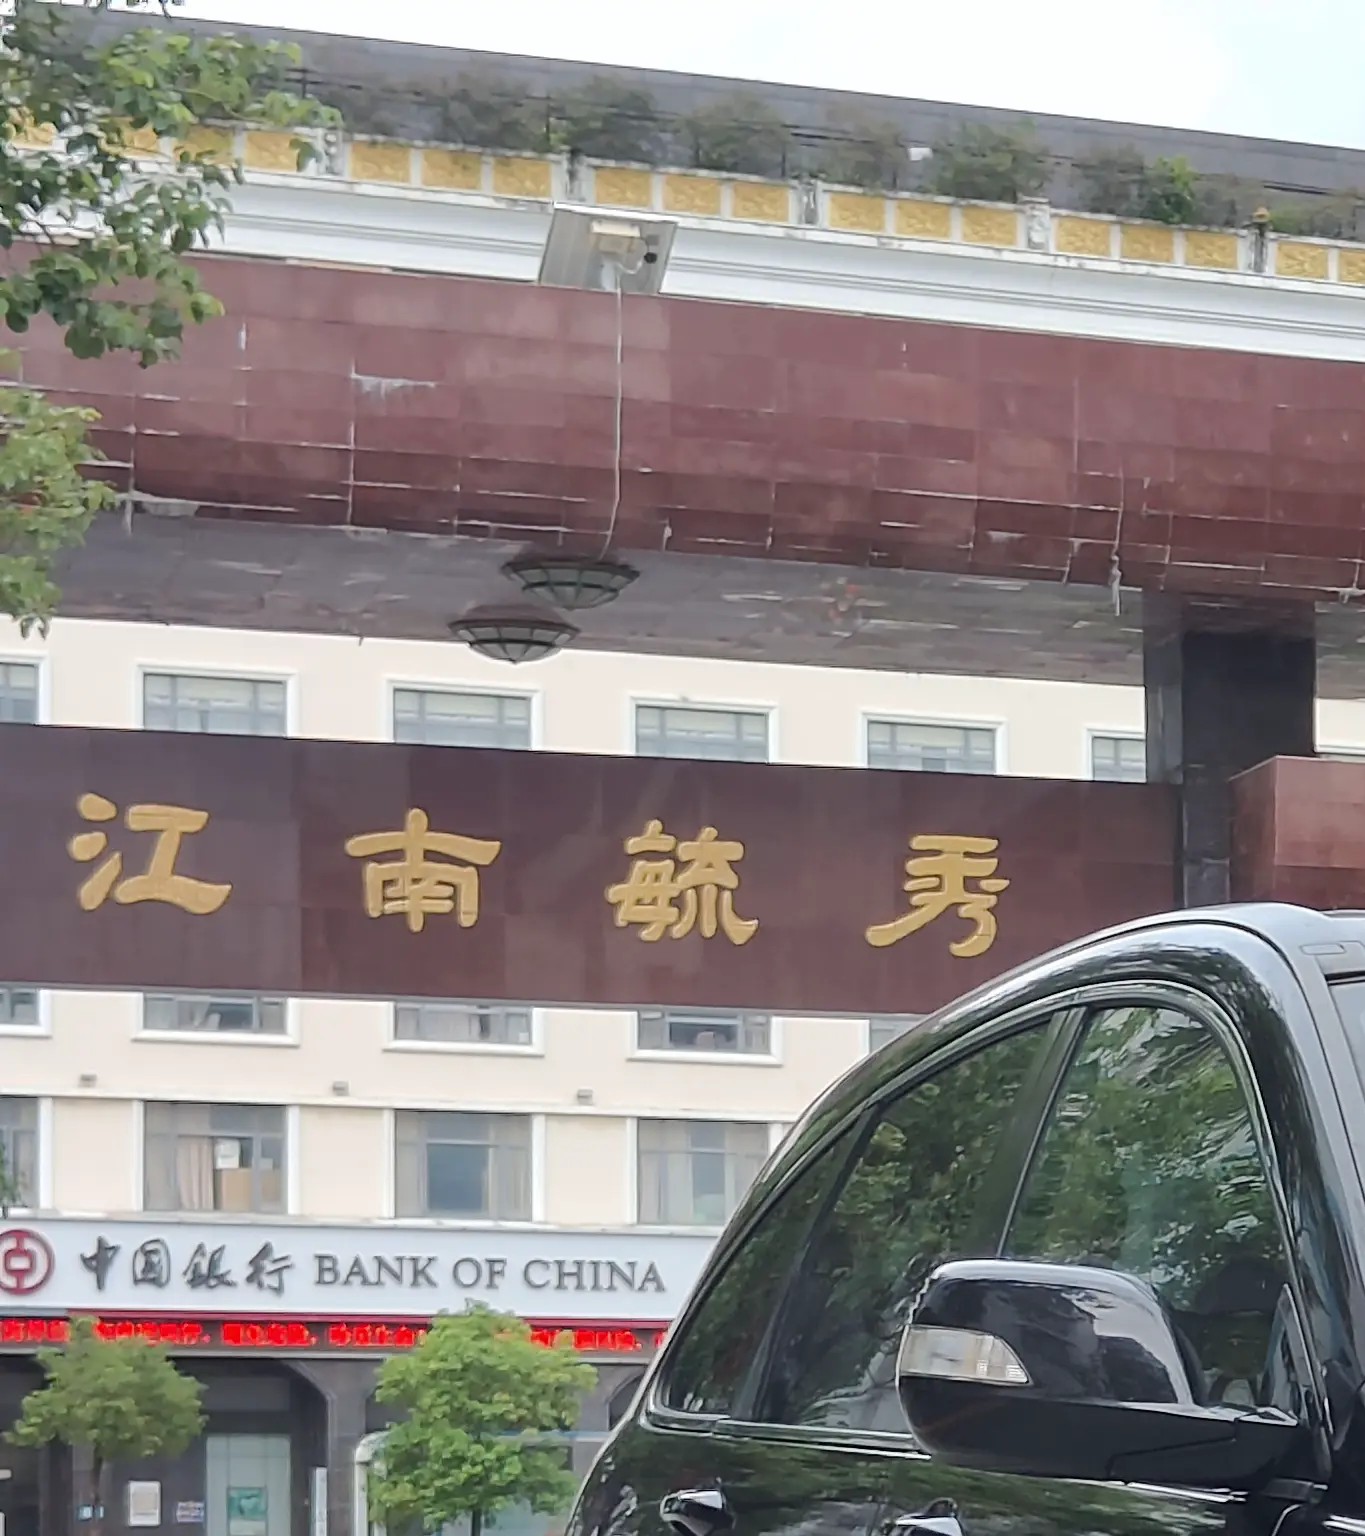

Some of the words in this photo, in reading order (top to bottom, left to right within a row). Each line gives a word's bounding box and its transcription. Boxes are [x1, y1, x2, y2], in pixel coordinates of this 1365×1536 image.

[67, 792, 1010, 957] 江南毓秀
[313, 1253, 438, 1287] BANK
[452, 1256, 507, 1289] OF
[523, 1258, 667, 1293] CHINA
